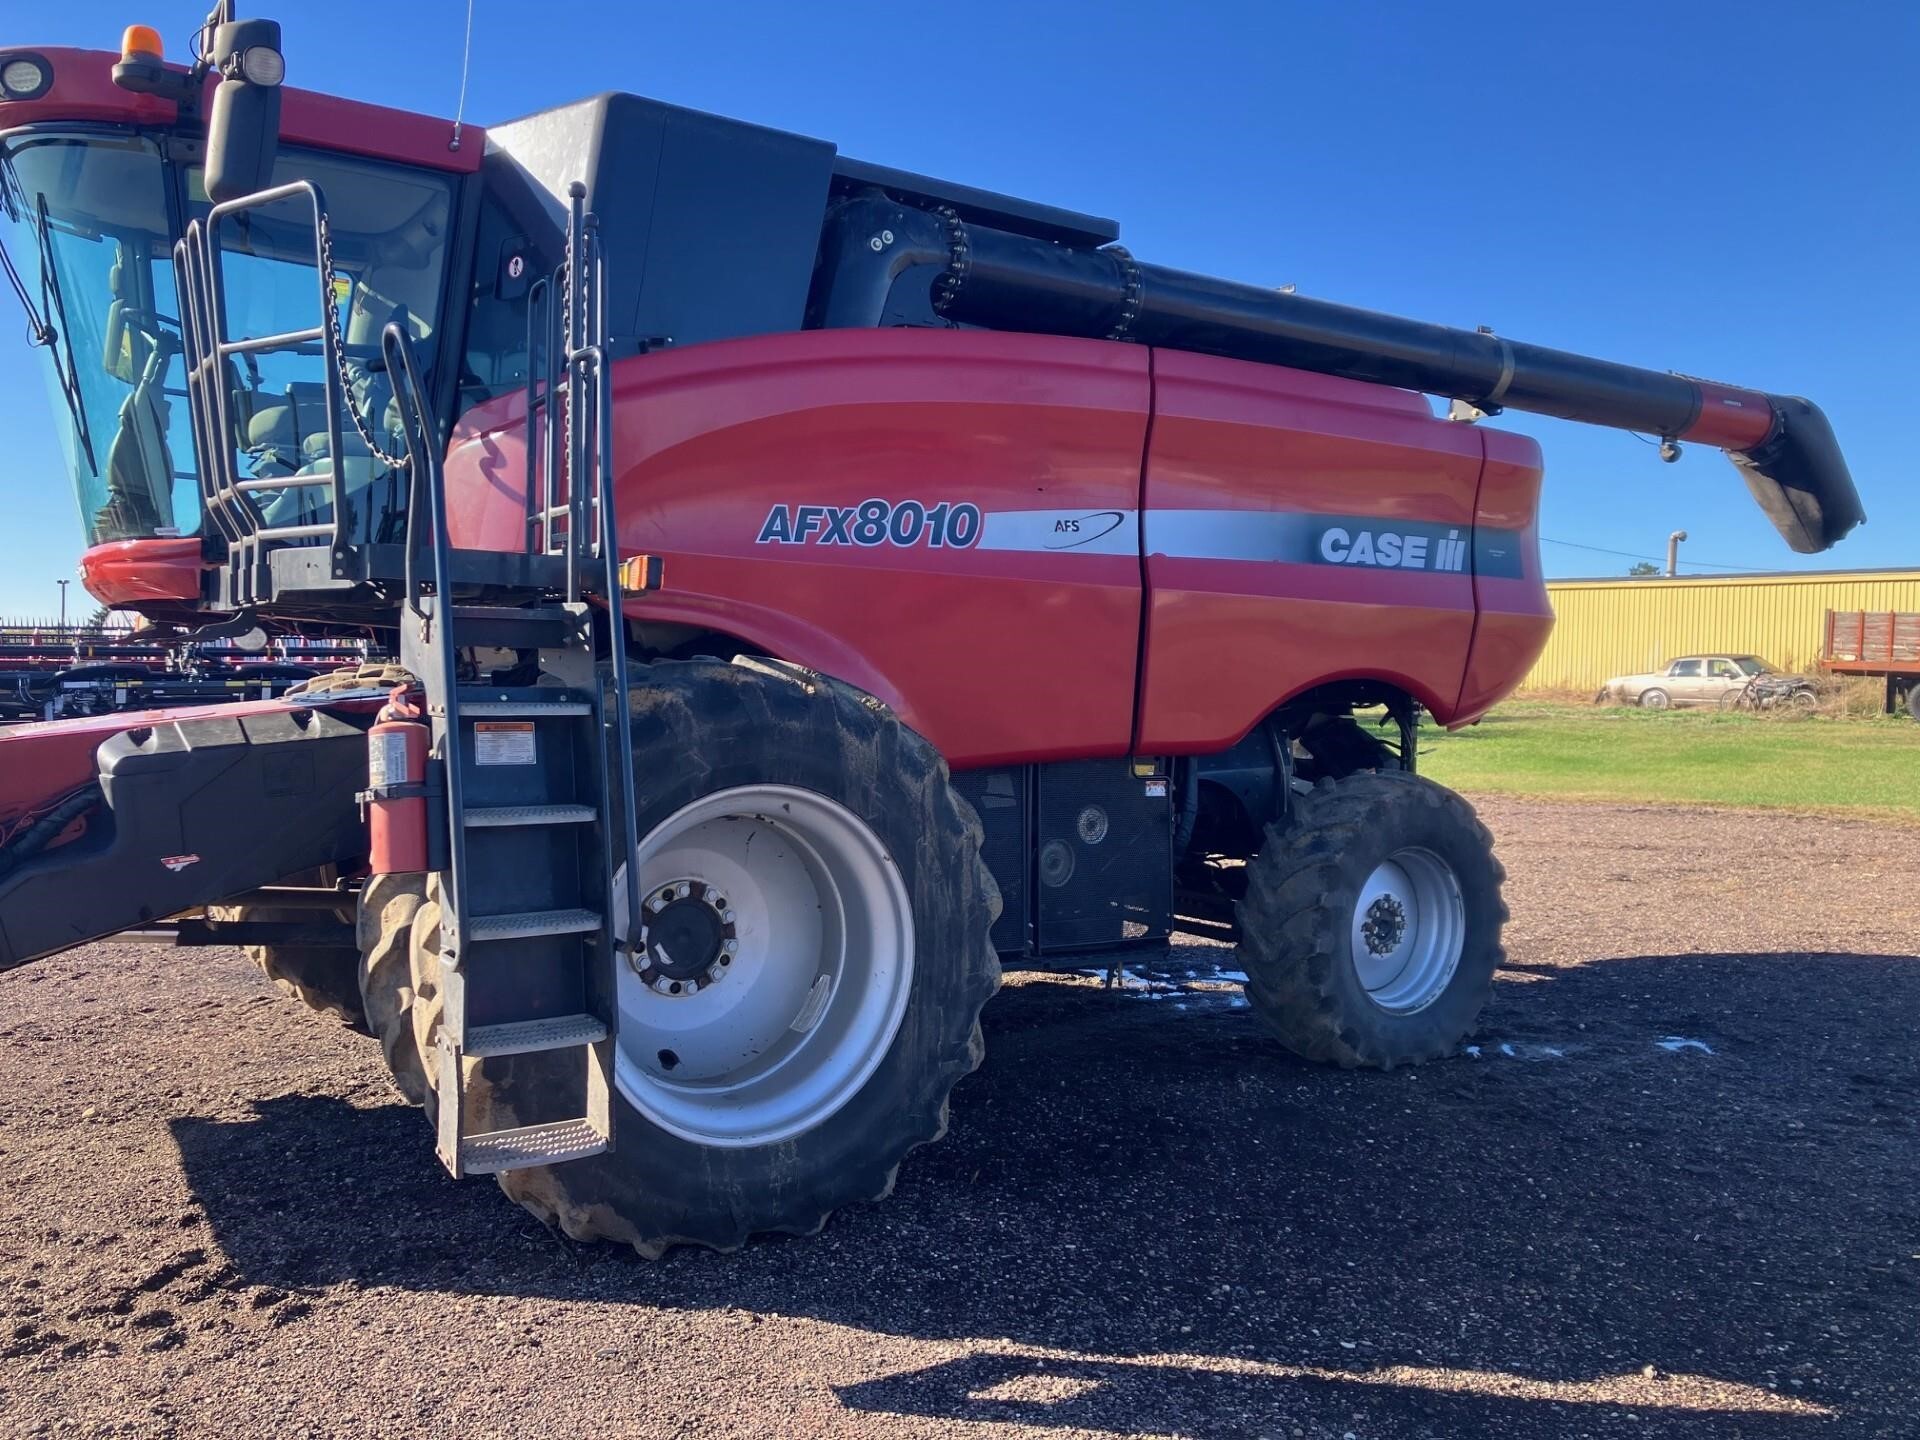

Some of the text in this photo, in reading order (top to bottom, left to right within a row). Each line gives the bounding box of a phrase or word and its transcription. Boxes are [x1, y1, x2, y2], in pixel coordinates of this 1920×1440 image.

[756, 497, 981, 549] AFX8010
[1054, 519, 1080, 533] AFS
[1320, 527, 1428, 569] CASE
